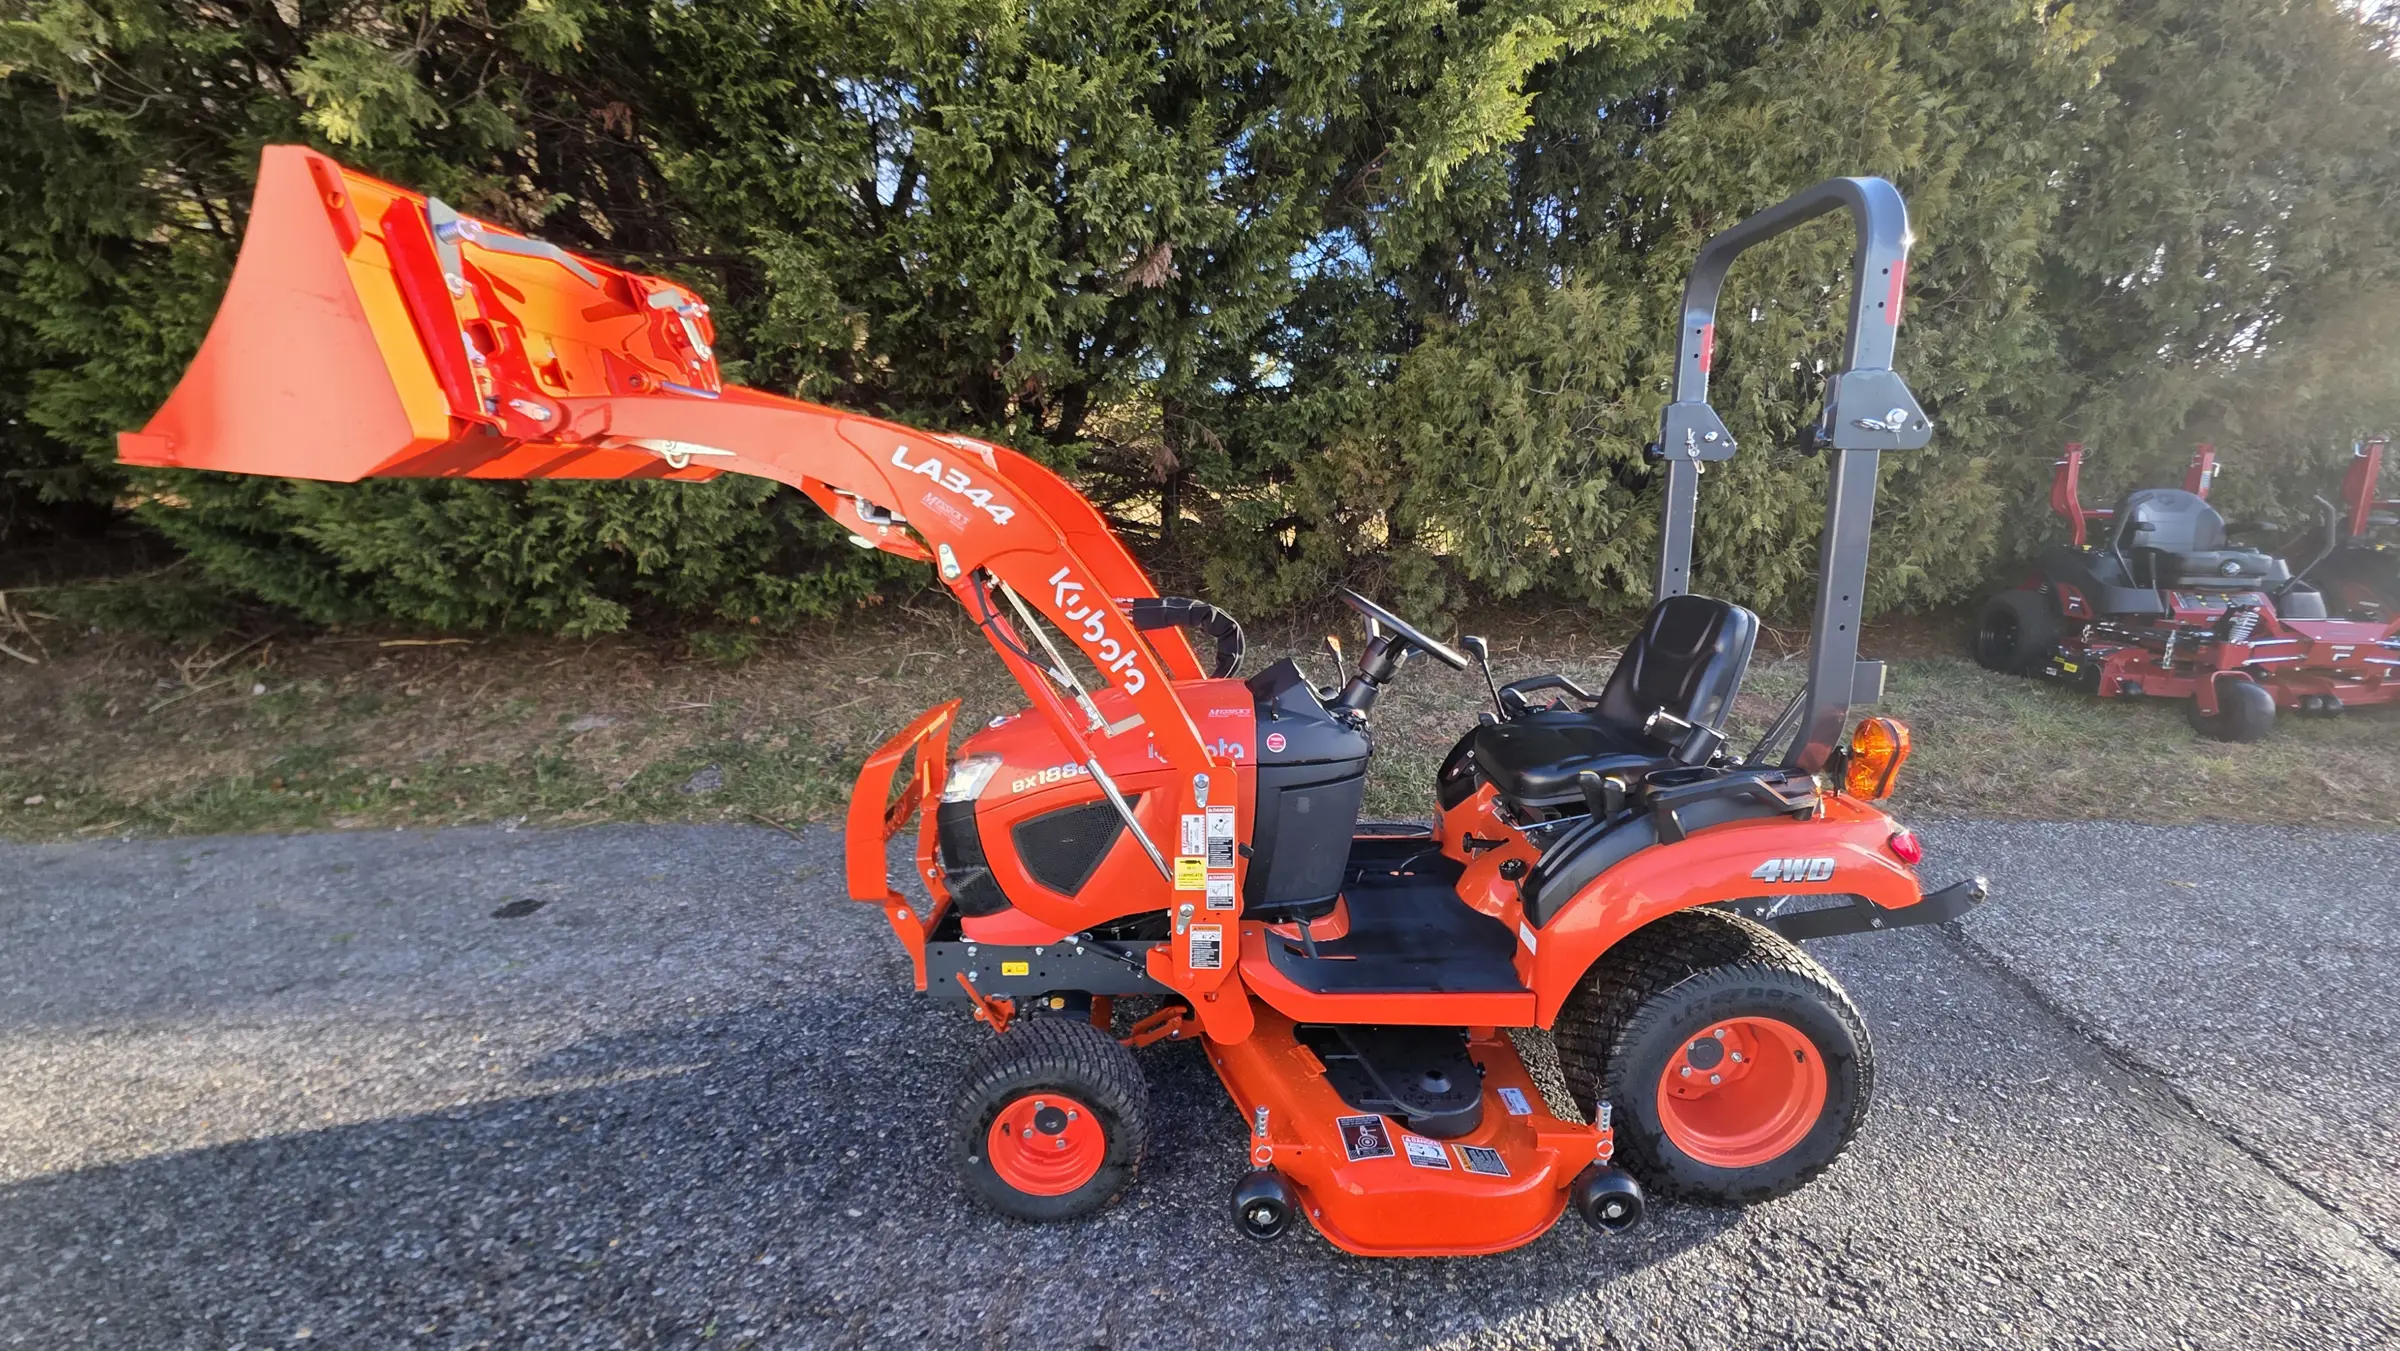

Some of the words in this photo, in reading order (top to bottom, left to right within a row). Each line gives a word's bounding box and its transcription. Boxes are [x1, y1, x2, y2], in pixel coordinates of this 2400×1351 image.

[891, 444, 1016, 526] LA344
[1048, 566, 1146, 696] Kubota
[1750, 858, 1837, 883] 4WD
